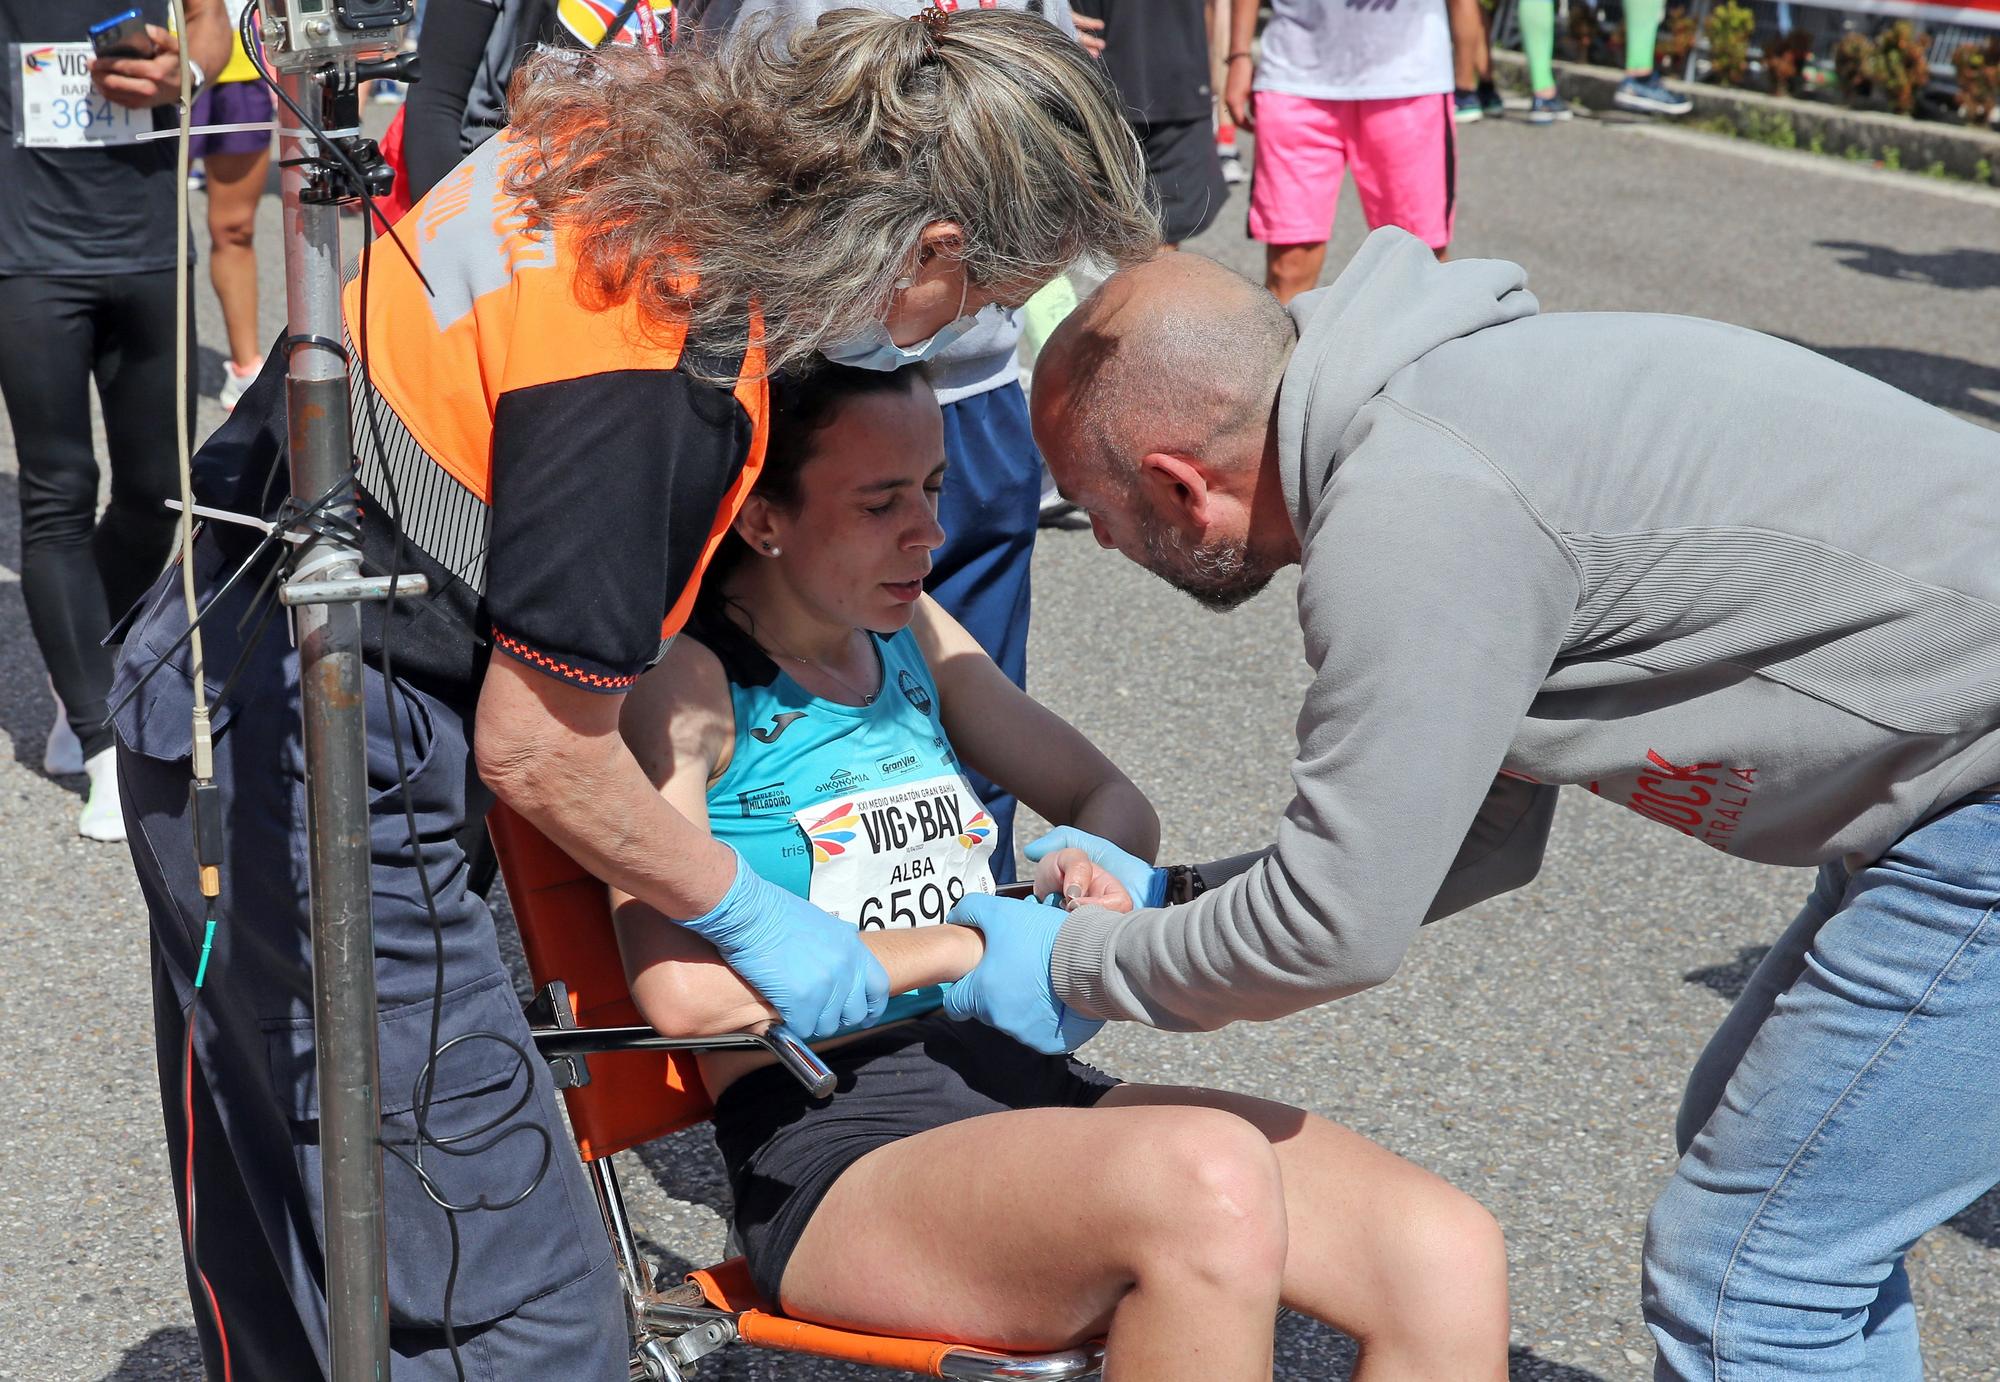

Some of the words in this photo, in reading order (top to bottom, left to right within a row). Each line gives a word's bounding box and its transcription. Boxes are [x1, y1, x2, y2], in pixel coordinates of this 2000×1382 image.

[58, 53, 88, 76] VIG
[814, 773, 870, 793] OIKONOMIA
[749, 795, 791, 811] MILLADOIRO
[869, 796, 889, 809] MEDIO
[921, 788, 939, 798] GRAN
[860, 806, 908, 855] VIG
[914, 794, 964, 842] BAY
[890, 856, 936, 885] ALBA
